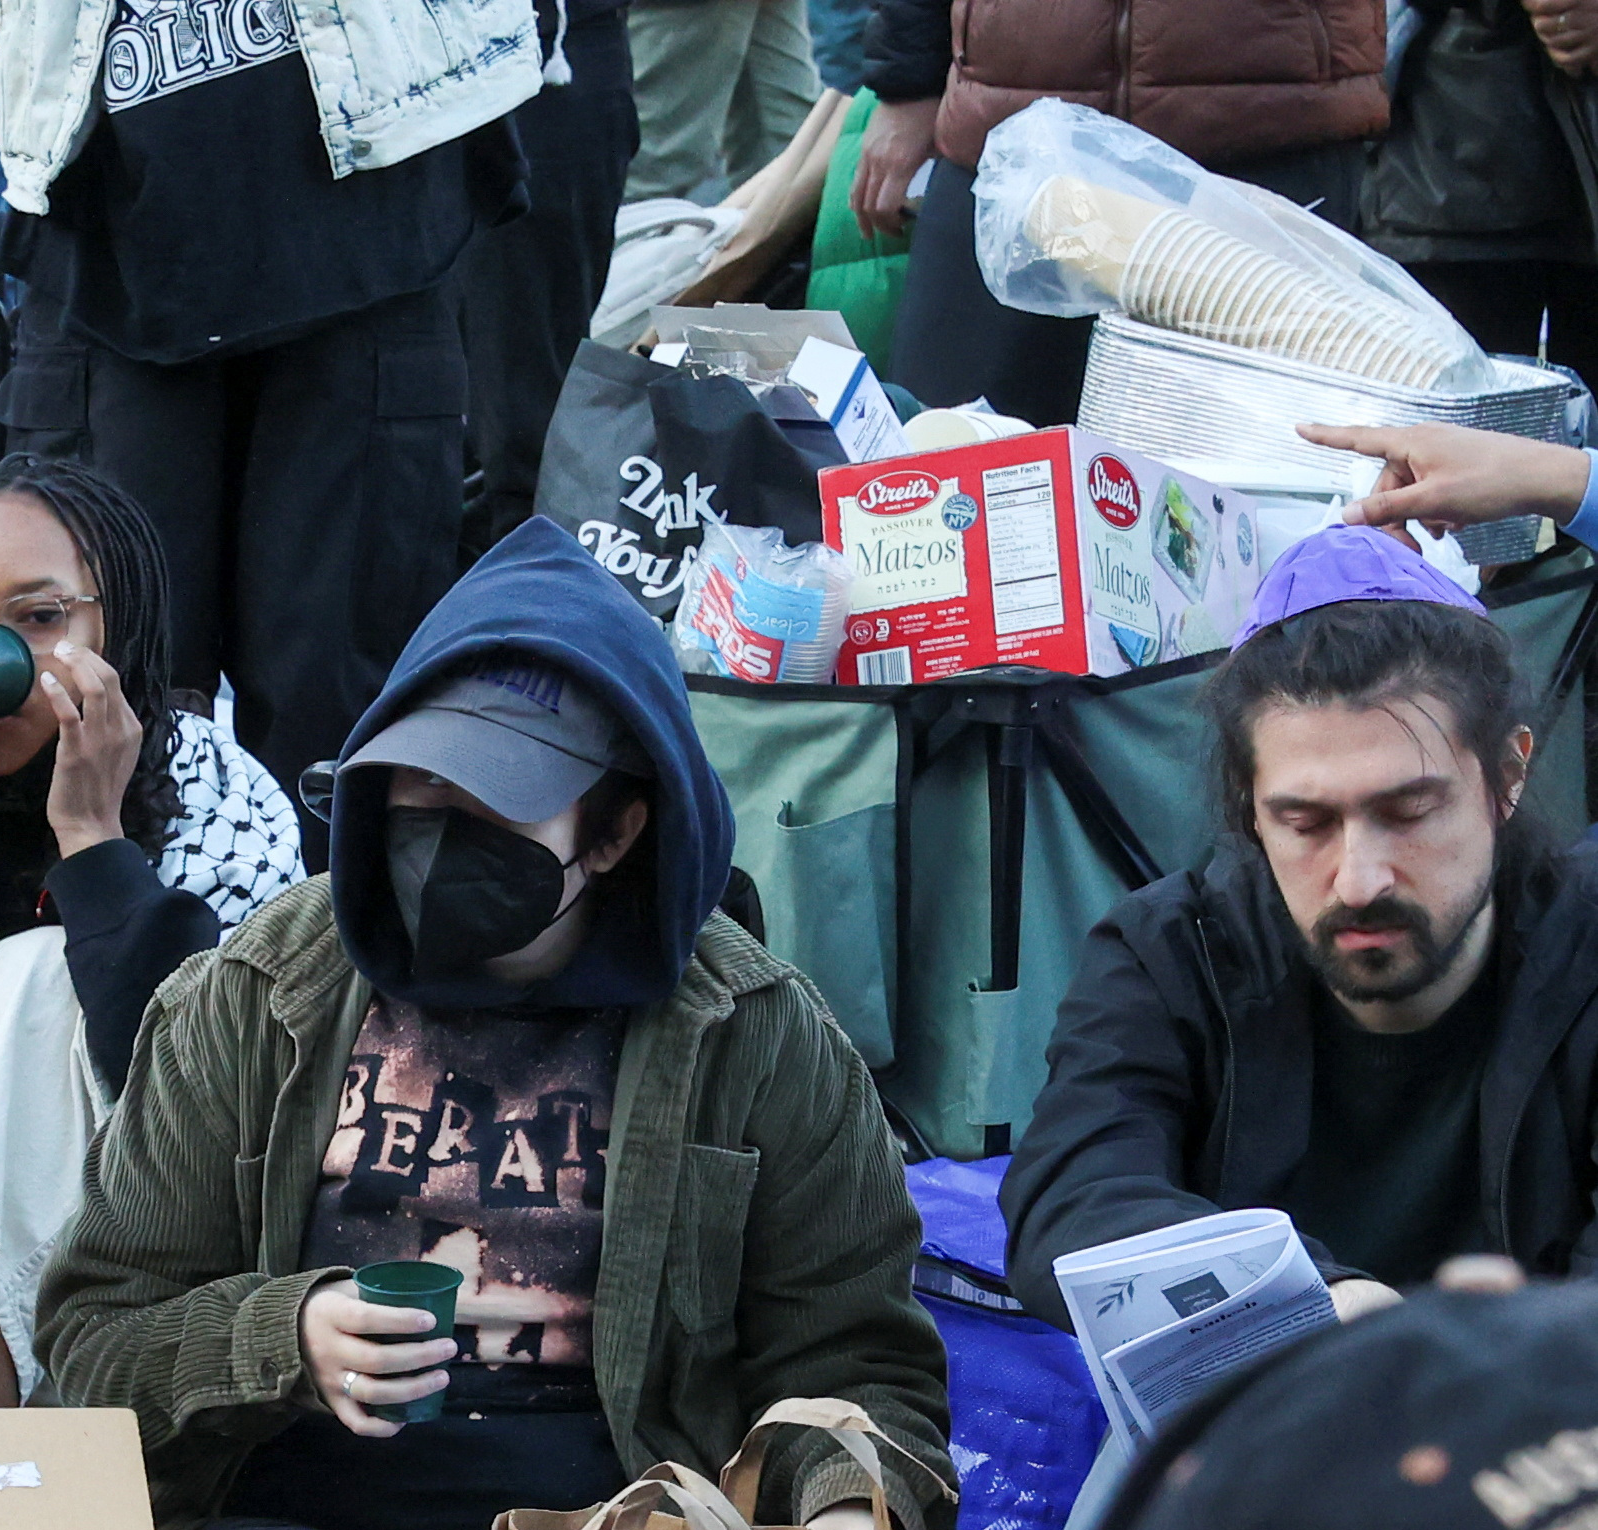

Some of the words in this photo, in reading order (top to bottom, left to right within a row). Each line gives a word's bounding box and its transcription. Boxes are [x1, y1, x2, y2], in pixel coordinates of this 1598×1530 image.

[985, 469, 1018, 480] Nutrition
[1020, 465, 1041, 474] Facts
[1090, 460, 1138, 516] Streit's
[861, 478, 934, 509] Streit's
[871, 518, 933, 536] PASSOVER
[948, 515, 968, 529] NY
[578, 520, 672, 585] You
[855, 538, 957, 577] Matzos
[1094, 542, 1151, 608] Matzos
[763, 614, 809, 636] Clear
